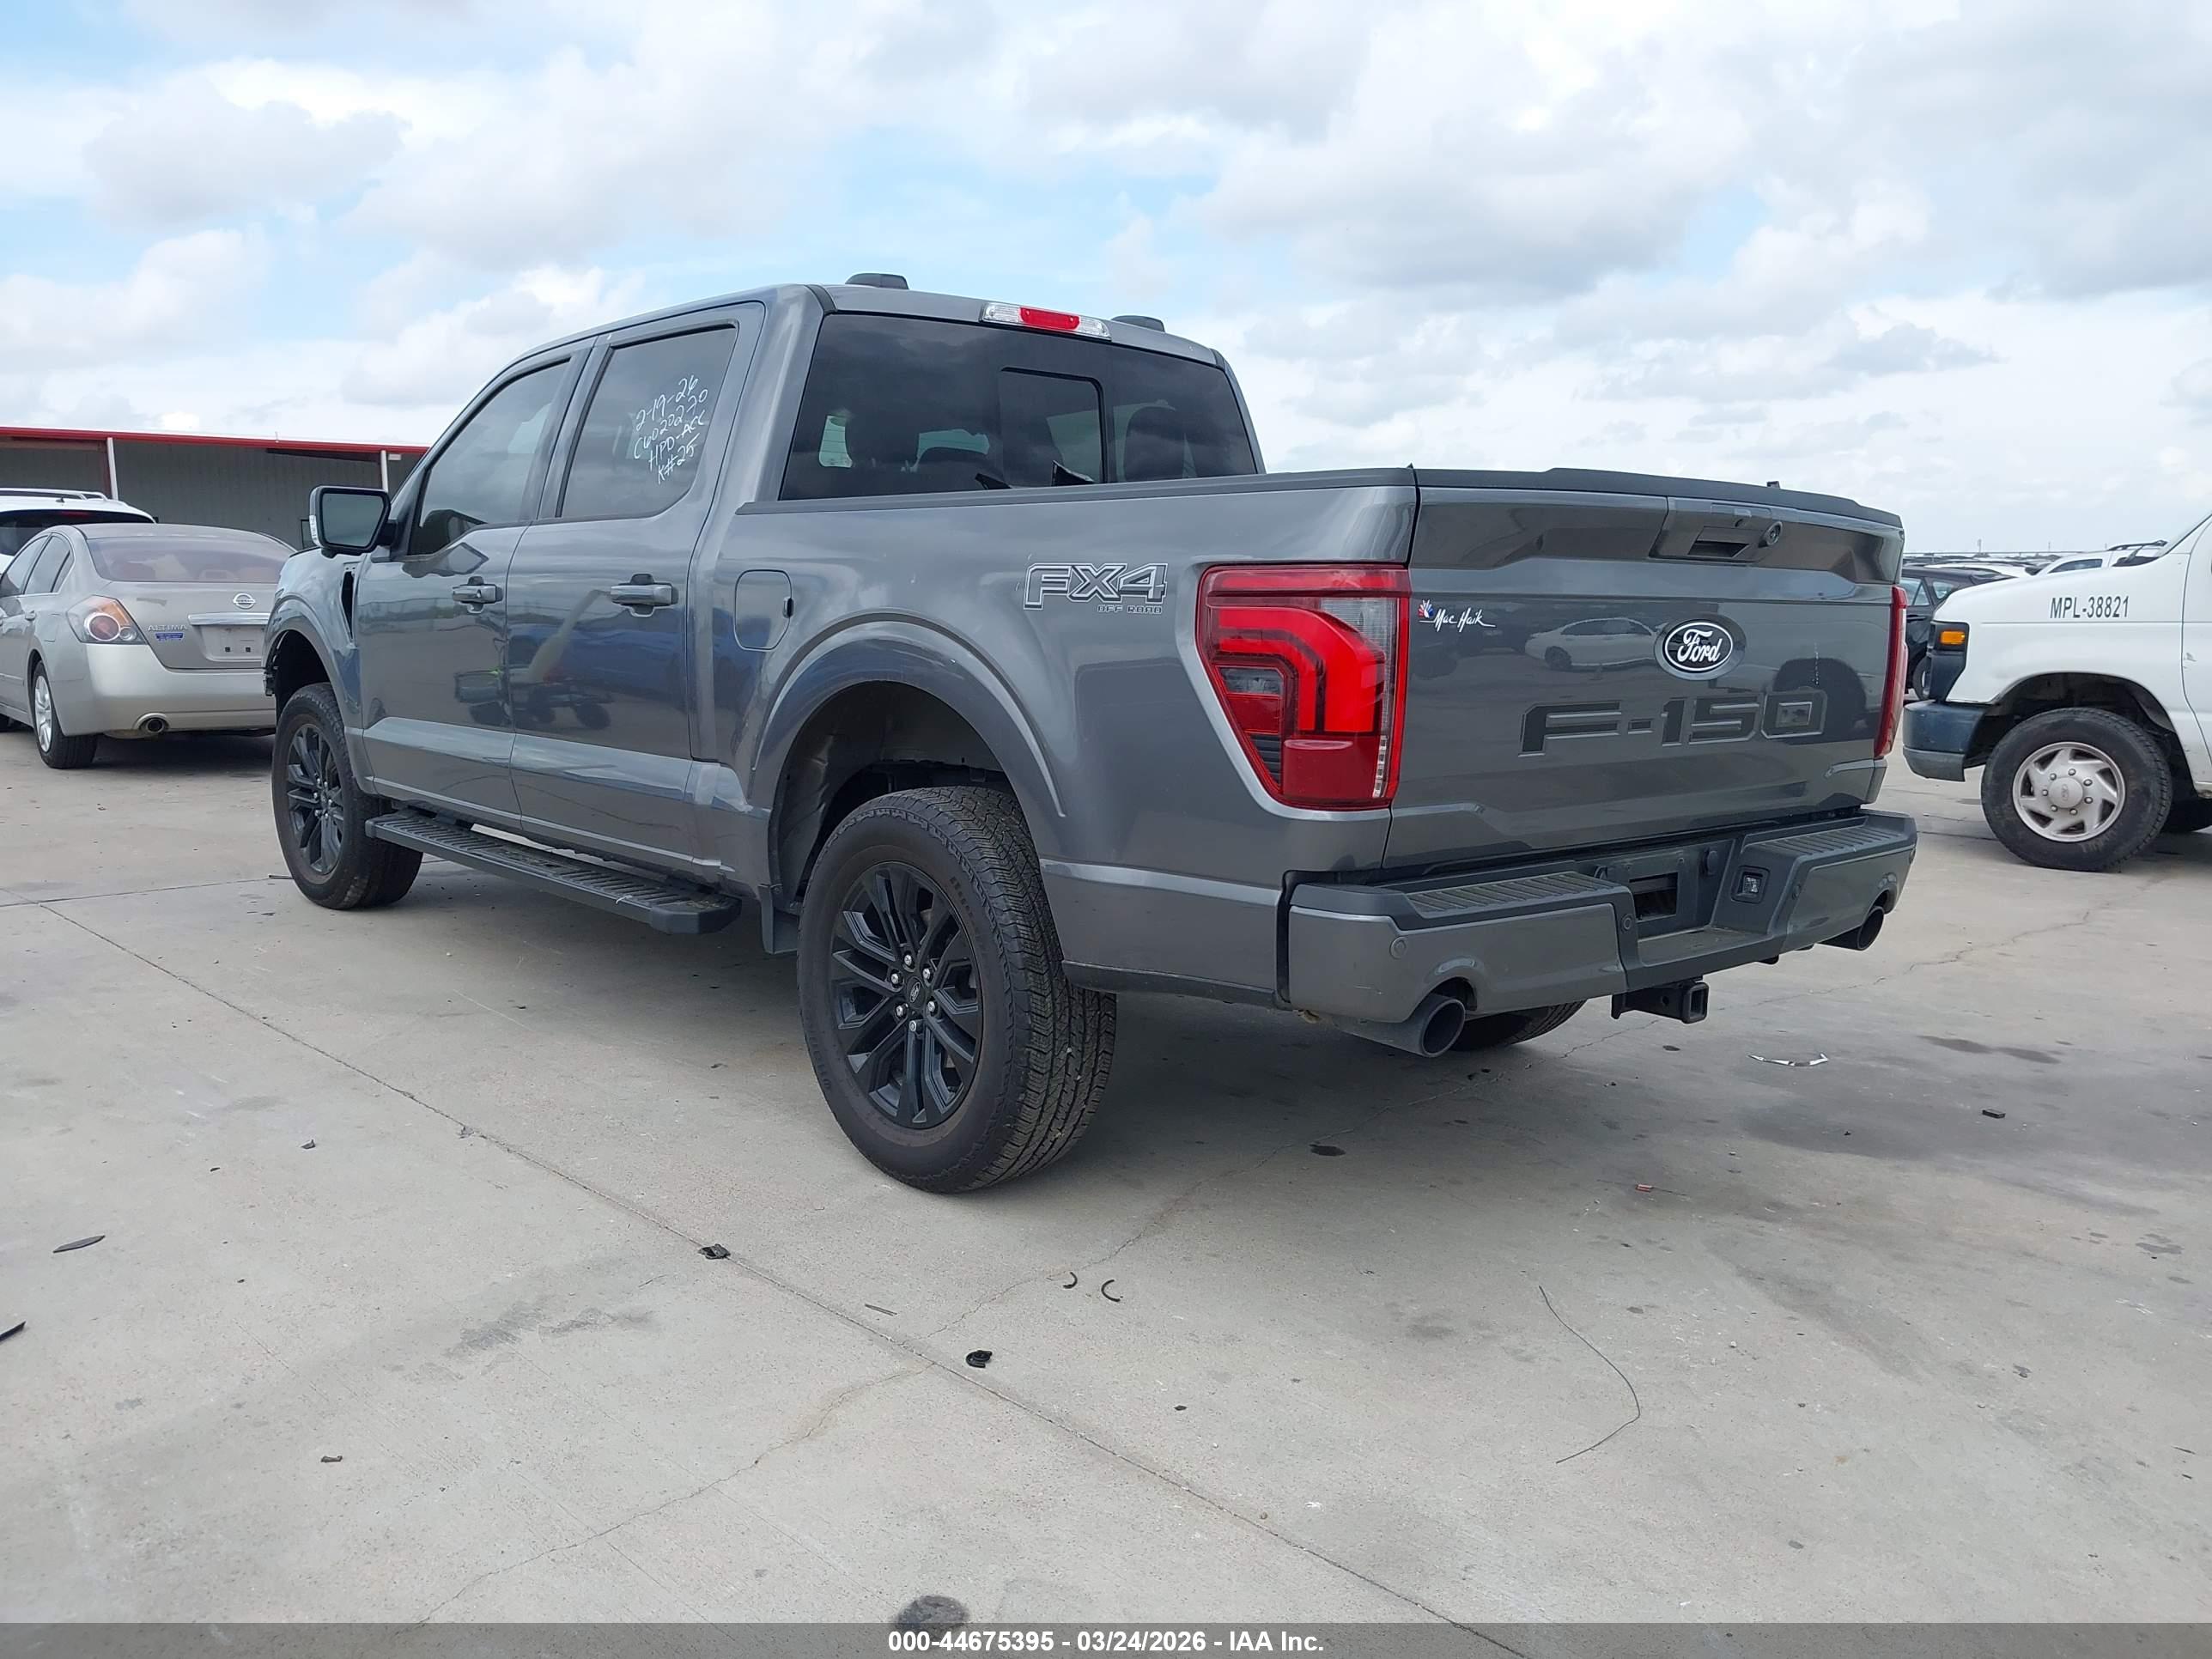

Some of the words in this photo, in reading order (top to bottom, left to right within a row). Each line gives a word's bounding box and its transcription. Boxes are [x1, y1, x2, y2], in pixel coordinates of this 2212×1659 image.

[1024, 563, 1168, 610] FX4
[1097, 605, 1122, 613] OFF
[1127, 605, 1163, 615] ROAD
[2050, 596, 2129, 618] MPL-38821
[1677, 629, 1723, 663] Ford
[1518, 689, 1828, 757] F-150
